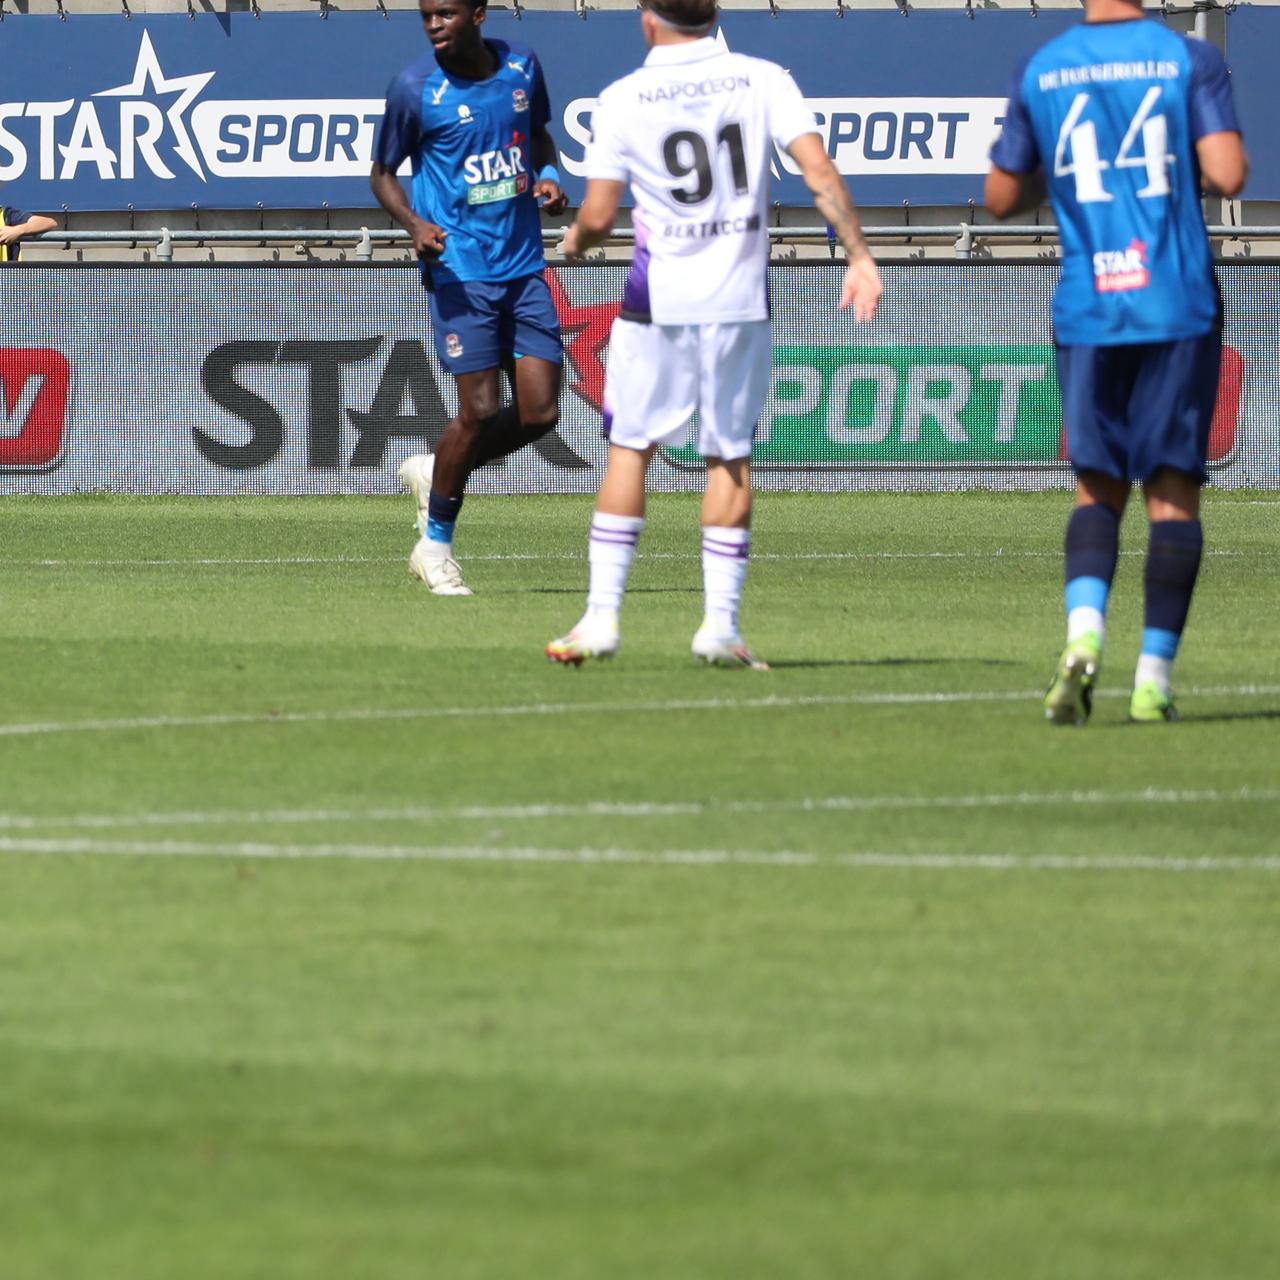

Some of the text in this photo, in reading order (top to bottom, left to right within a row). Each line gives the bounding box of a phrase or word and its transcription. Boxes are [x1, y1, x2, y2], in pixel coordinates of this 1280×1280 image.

[638, 75, 751, 104] NAPOLEON
[814, 111, 970, 161] PORT
[1053, 85, 1177, 204] 44
[463, 146, 526, 185] STAR
[662, 122, 749, 205] 91
[470, 180, 515, 201] SPORT
[1093, 248, 1144, 276] STAR
[754, 362, 1048, 445] PORT
